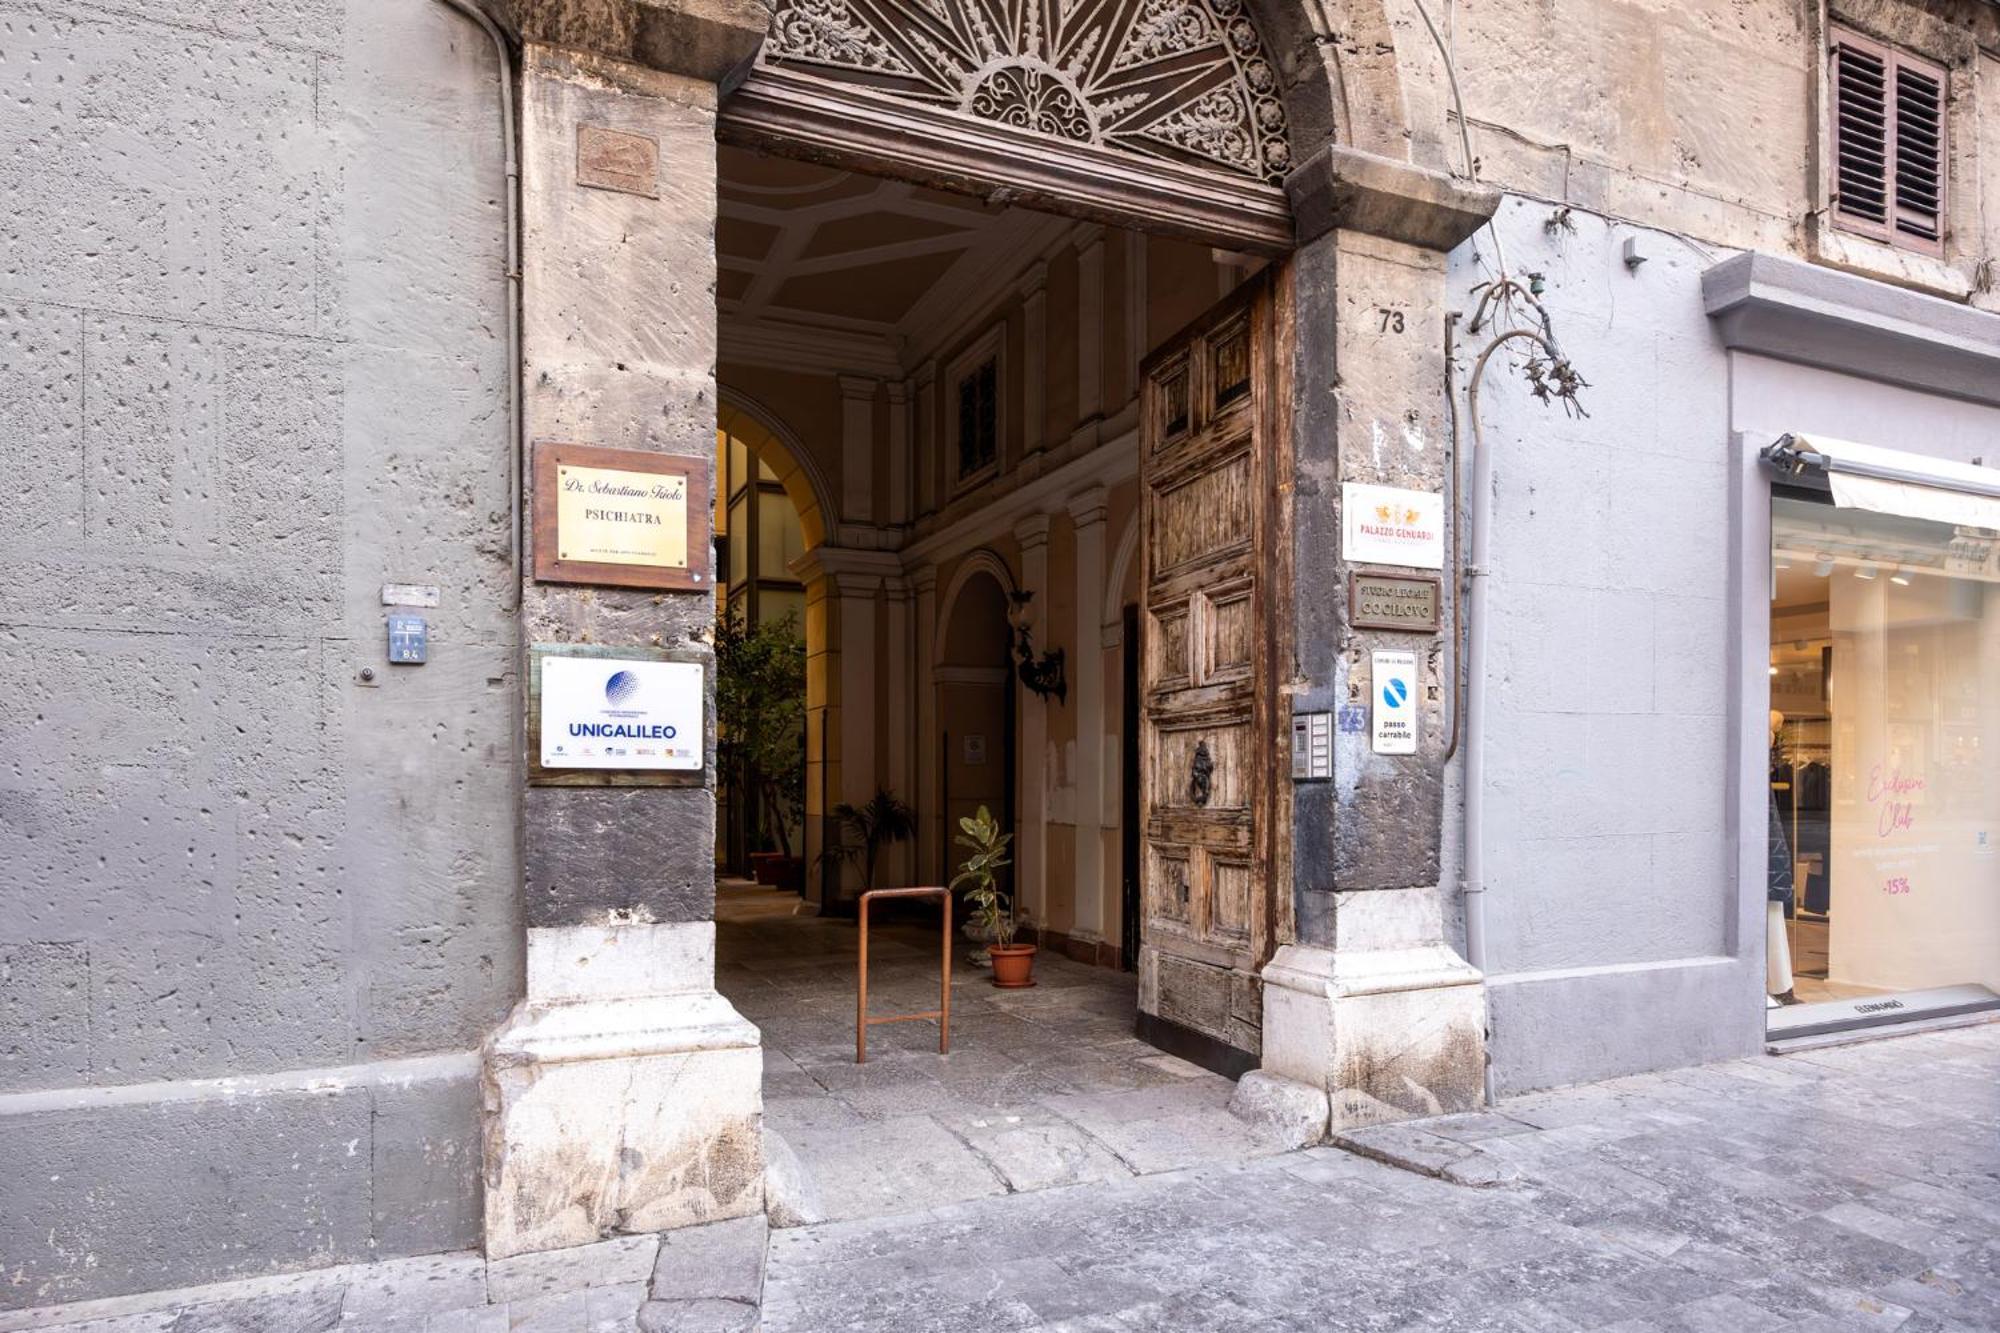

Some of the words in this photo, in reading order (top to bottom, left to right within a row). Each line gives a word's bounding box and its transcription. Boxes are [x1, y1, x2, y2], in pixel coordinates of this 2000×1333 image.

[1379, 308, 1404, 334] 73
[588, 480, 648, 498] Sebastiano
[585, 508, 661, 525] PSICHIATRA
[1360, 524, 1394, 537] PALAZZO
[569, 723, 677, 739] UNIGALILEO
[1384, 721, 1406, 729] passo
[1378, 731, 1412, 740] carrabile
[1882, 877, 1910, 895] -15%
